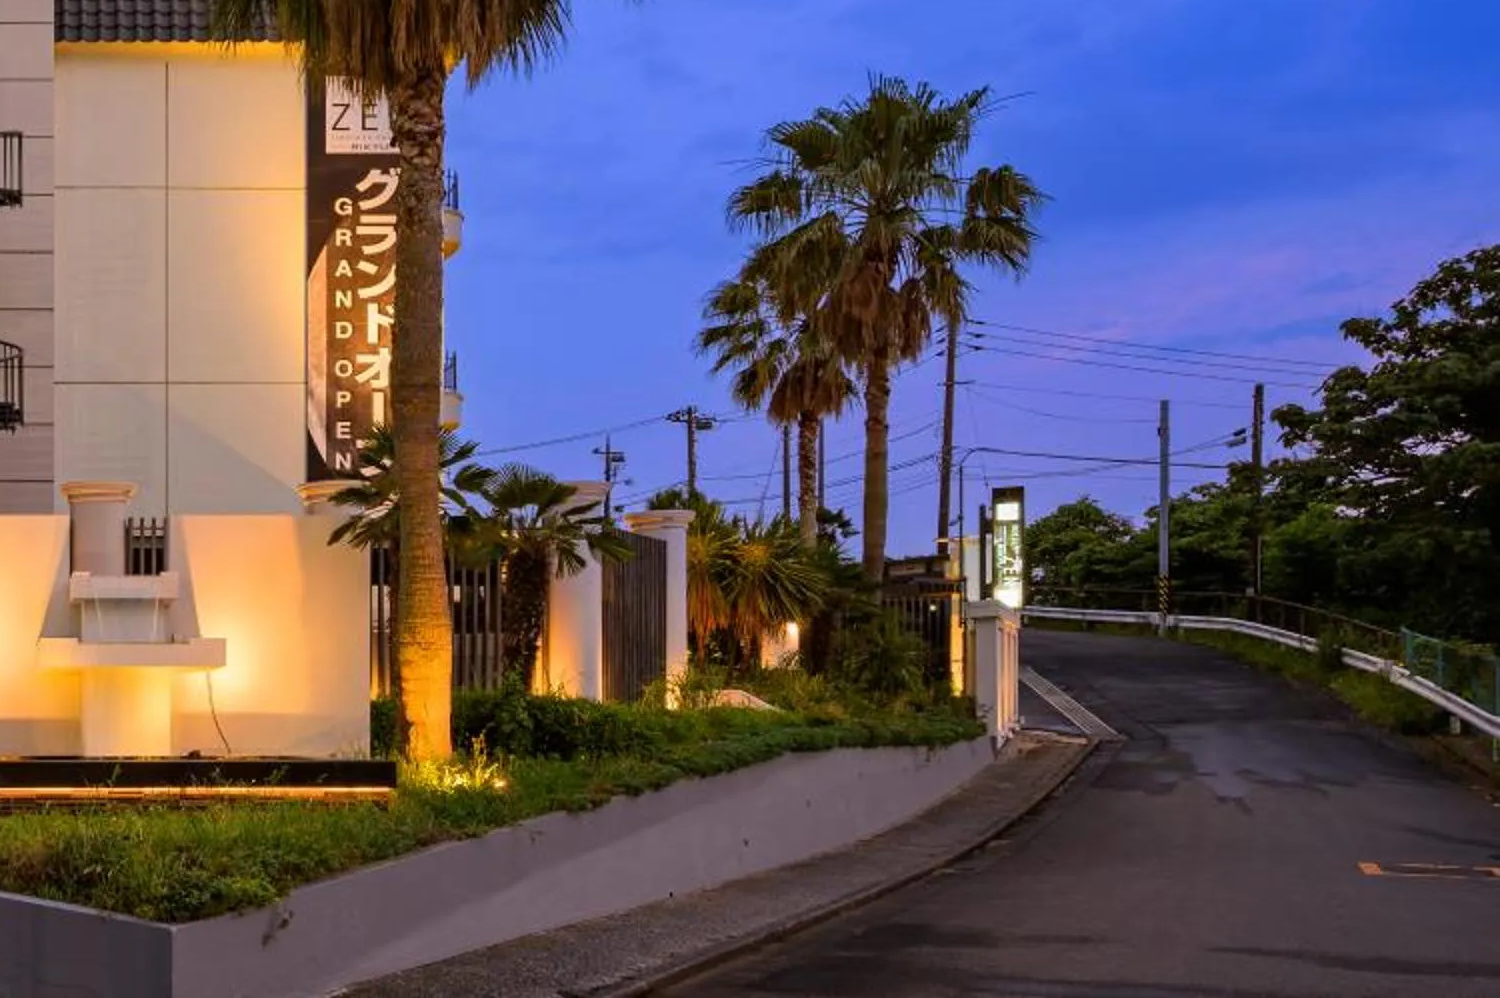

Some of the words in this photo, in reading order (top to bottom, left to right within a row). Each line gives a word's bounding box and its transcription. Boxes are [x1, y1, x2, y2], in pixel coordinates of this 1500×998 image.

[331, 103, 378, 131] ZE
[334, 197, 354, 339] GRAND
[334, 359, 354, 470] OPEN
